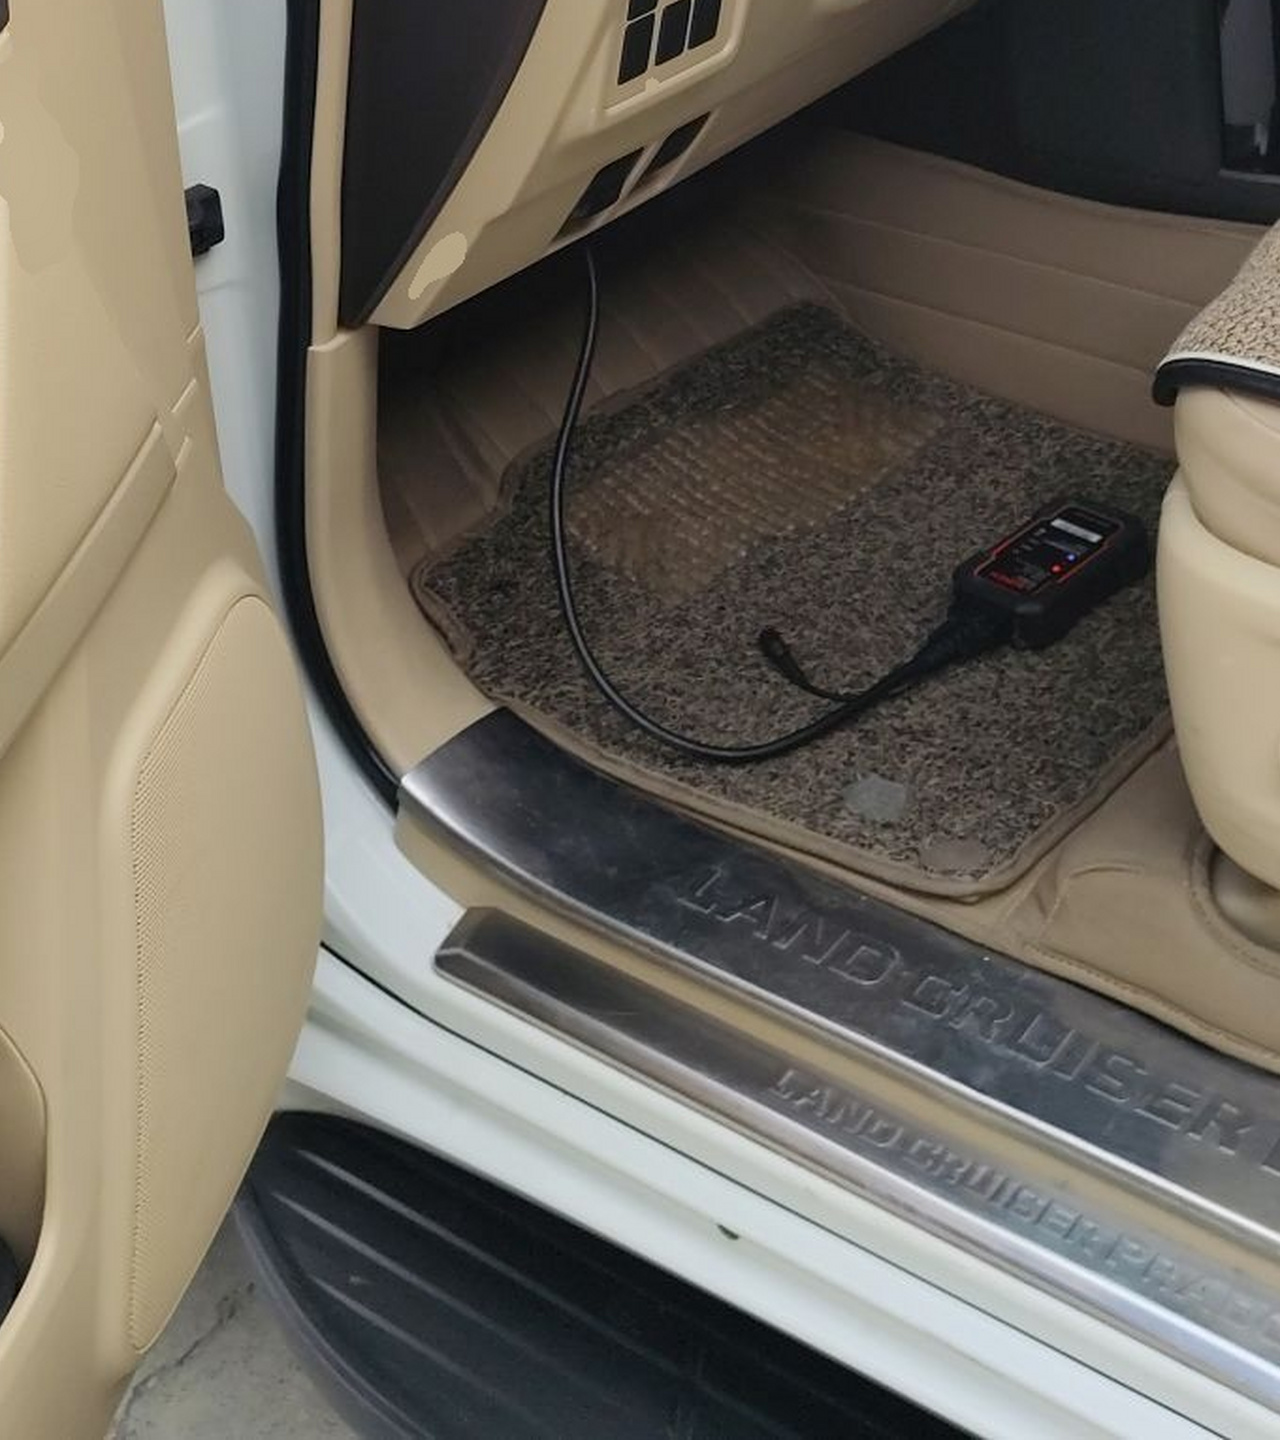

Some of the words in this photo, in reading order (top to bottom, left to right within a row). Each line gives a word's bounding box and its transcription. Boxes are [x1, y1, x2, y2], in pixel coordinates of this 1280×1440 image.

[677, 863, 902, 986] LAND
[902, 973, 1252, 1157] CRUISER
[770, 1067, 905, 1148] LAND
